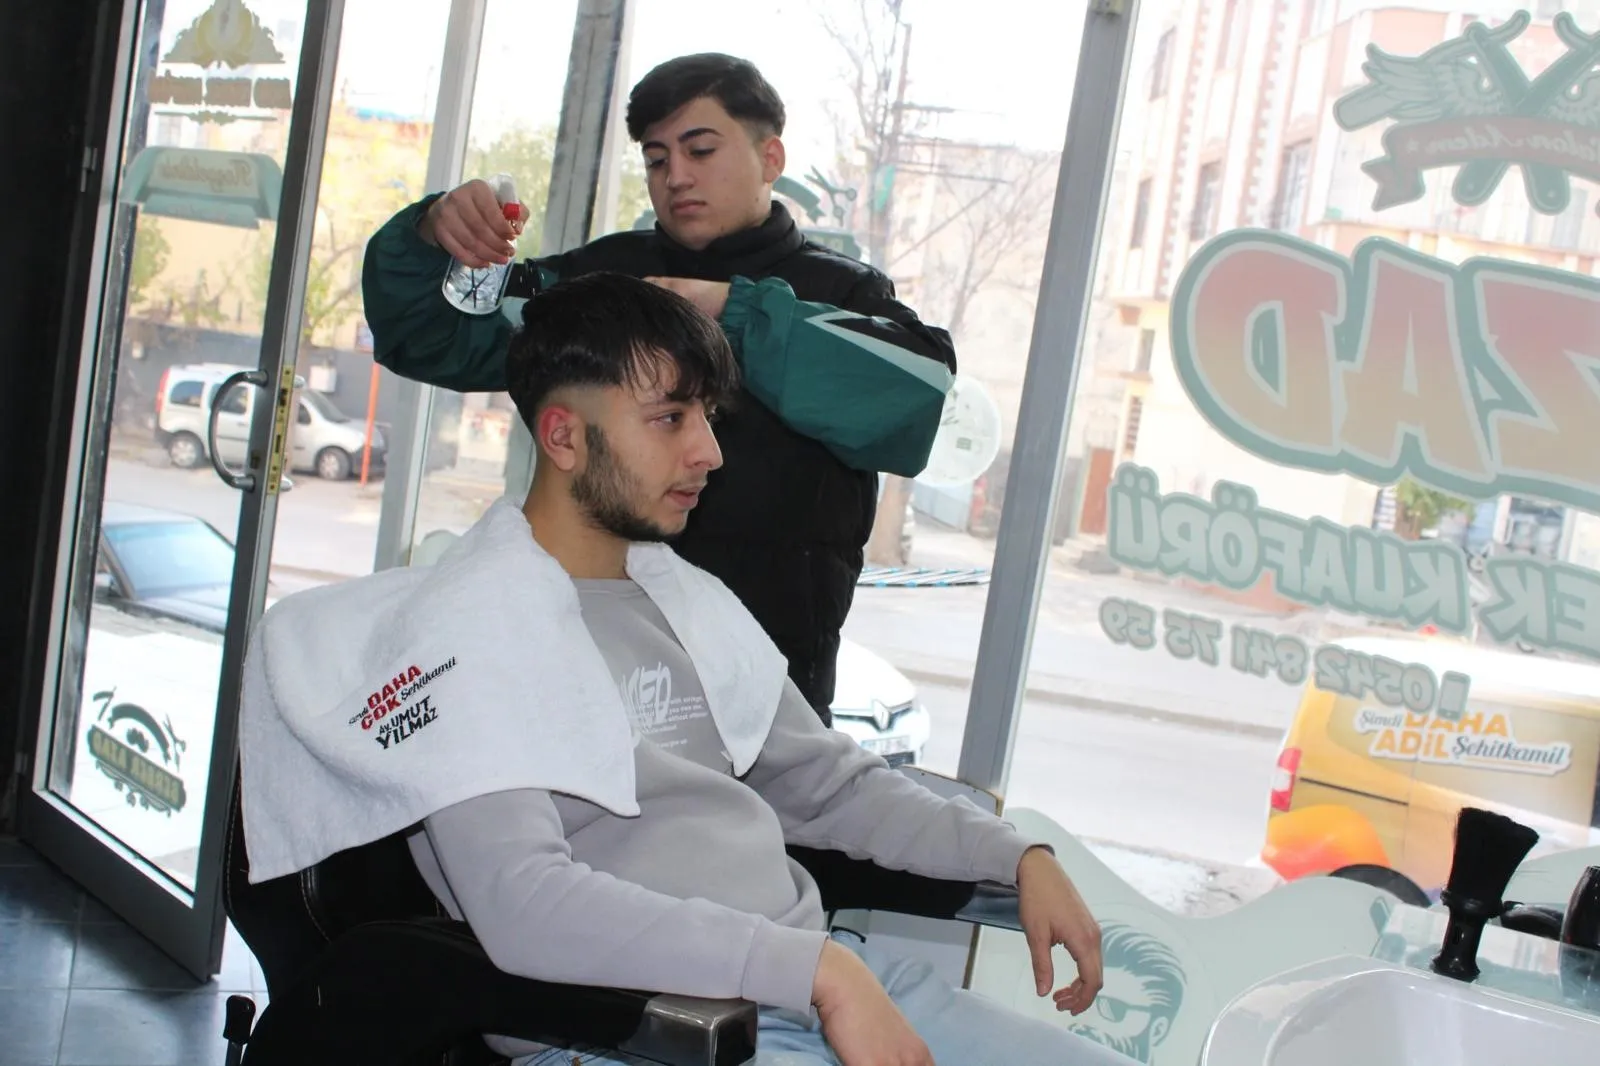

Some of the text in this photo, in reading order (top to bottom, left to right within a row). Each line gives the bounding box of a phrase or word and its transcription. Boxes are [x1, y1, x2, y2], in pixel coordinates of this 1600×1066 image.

[367, 665, 422, 709] DAHA
[375, 707, 439, 750] YILMAZ
[390, 695, 431, 727] UMUT
[1452, 735, 1566, 765] Şehitkamil
